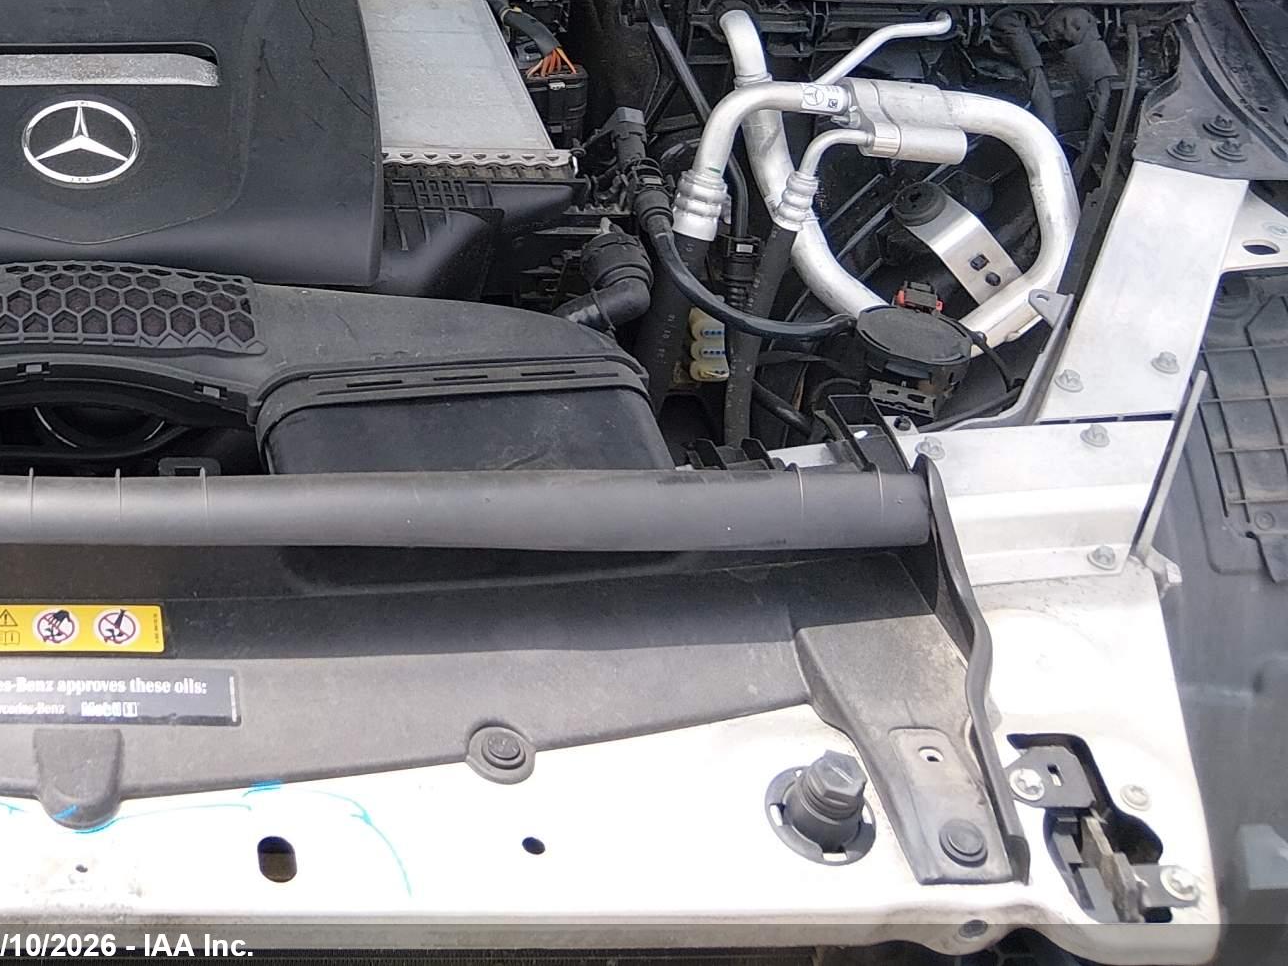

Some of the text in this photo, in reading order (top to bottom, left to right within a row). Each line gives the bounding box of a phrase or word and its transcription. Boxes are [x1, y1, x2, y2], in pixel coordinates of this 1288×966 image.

[56, 679, 127, 696] approves
[129, 677, 171, 694] these
[174, 677, 208, 695] oils:
